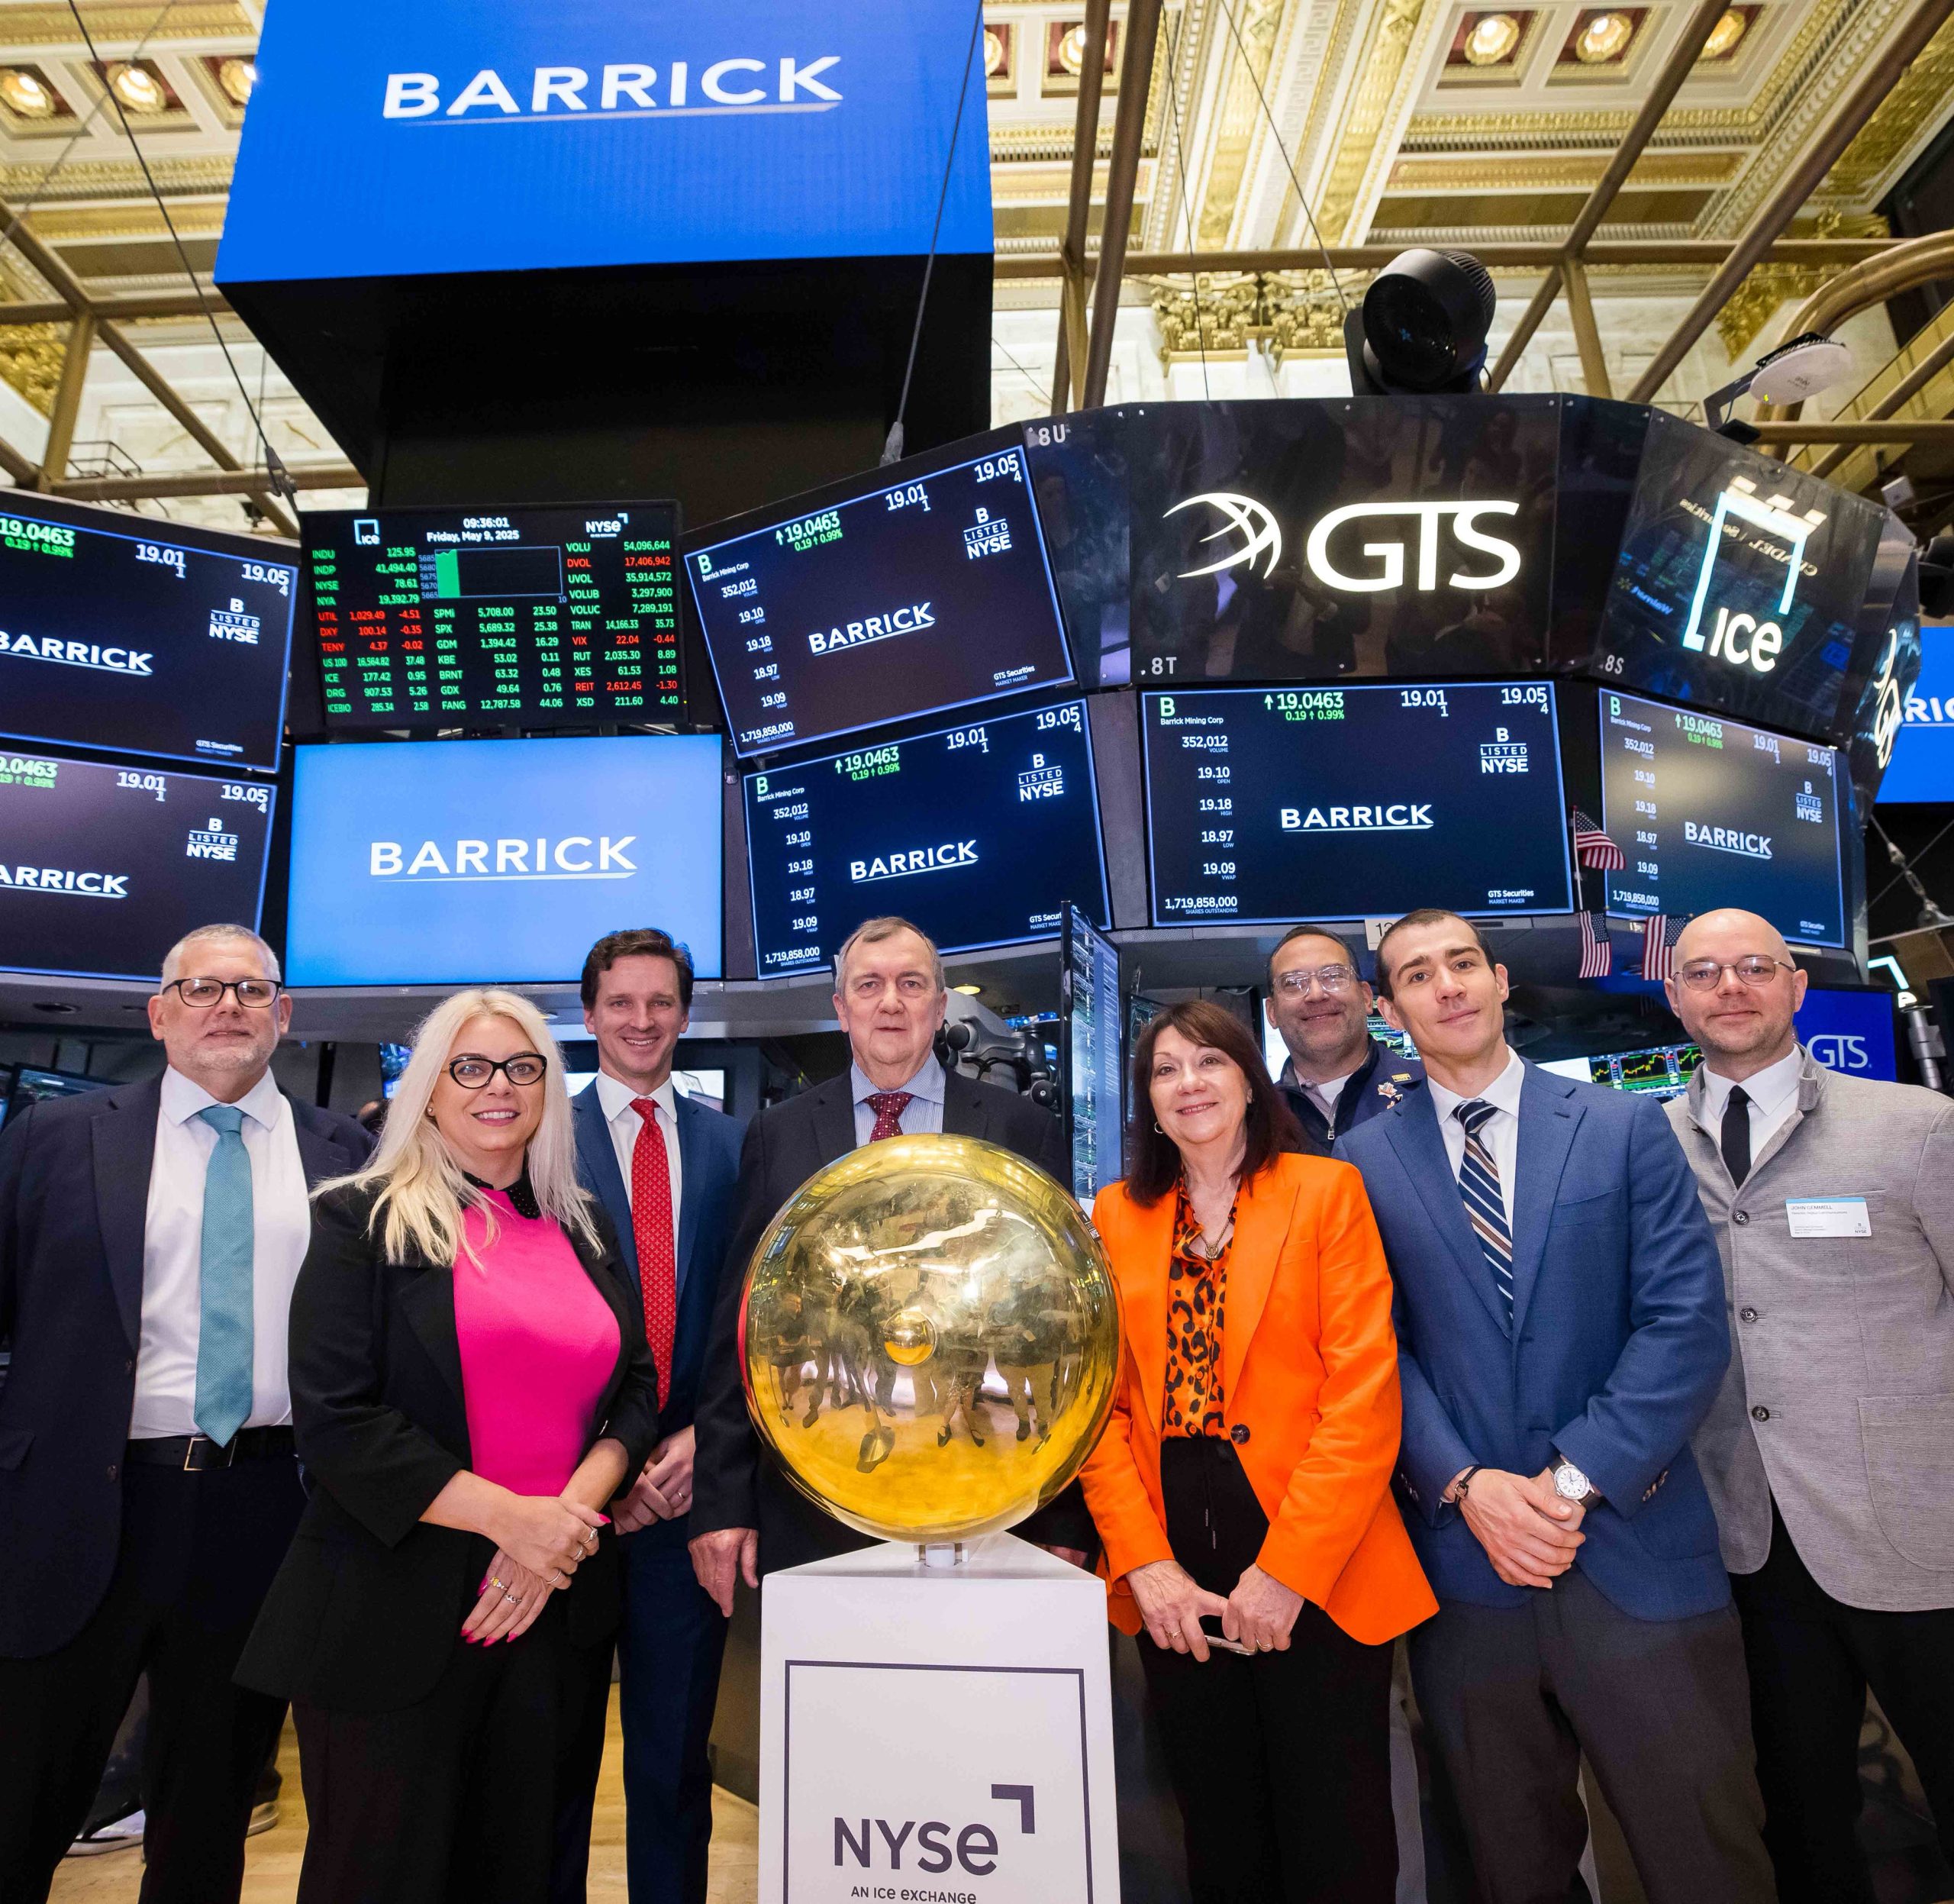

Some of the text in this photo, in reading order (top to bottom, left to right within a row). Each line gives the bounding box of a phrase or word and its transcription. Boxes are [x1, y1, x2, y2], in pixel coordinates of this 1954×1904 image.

[383, 56, 843, 119] BARRICK
[1038, 424, 1066, 446] 8U
[975, 453, 1018, 482] 19.05
[886, 485, 928, 511] 19.01
[463, 517, 509, 528] 09:36:01
[975, 508, 988, 523] B
[0, 518, 75, 546] 19.0463
[785, 511, 841, 542] 19.0463
[964, 522, 1008, 541] LISTED
[427, 530, 519, 543] Friday, May 9, 2025
[566, 541, 670, 552] VOLU 54,096,644
[967, 534, 1012, 560] NYSE
[1307, 500, 1521, 592] GTS
[136, 544, 185, 566] 19.01
[567, 557, 670, 567] DVOL 17,406,942
[698, 554, 712, 573] B
[242, 563, 289, 586] 19.05
[568, 573, 672, 583] UVOL 35,914,572
[569, 588, 672, 599] VOLUB 3,297,900
[721, 579, 756, 598] 352,012
[478, 607, 514, 618] 5,708.00
[533, 606, 556, 615] 23.50
[570, 603, 673, 615] VOLUC 7,289,191
[739, 607, 763, 623] 19.10
[211, 613, 260, 628] LISTED
[435, 621, 557, 634] SPX 5,689.32 25.38
[572, 619, 674, 630] TRAN 14,166.33 35.73
[808, 602, 936, 653] BARRICK
[209, 624, 258, 644] NYSE
[572, 637, 587, 645] VIX
[616, 635, 639, 644] 22.04
[437, 637, 559, 649] GDM 1,394.42 16.29
[746, 636, 771, 651] 19.18
[438, 653, 559, 664] KBE 53.02 0.11
[574, 650, 676, 661] RUT 2,035.30 8.89
[575, 666, 676, 676] XES 61.53 1.08
[754, 664, 777, 679] 18.97
[1151, 657, 1177, 674] 8T
[1604, 654, 1623, 675] 8S
[440, 668, 561, 679] BRNT 63.32 0.48
[576, 681, 677, 691] REIT 2,612.45 -1.30
[577, 696, 679, 706] XSD 211.60 4.40
[761, 692, 785, 707] 19.09
[1277, 692, 1344, 710] 19.0463
[1401, 691, 1447, 708] 19.01
[1501, 687, 1547, 705] 19.05
[442, 699, 563, 710] FANG 12,787.58 44.06
[1160, 697, 1175, 717] B
[1440, 705, 1448, 717] 1
[1540, 703, 1549, 714] 4
[1037, 706, 1080, 730] 19.05
[1286, 710, 1344, 721] 0.19 0.99%
[740, 721, 793, 742] 1,719,858,000
[1683, 715, 1722, 739] 19.0463
[946, 728, 988, 750] 19.01
[1182, 735, 1228, 748] 352,012
[1497, 728, 1509, 742] B
[1481, 746, 1527, 756] LISTED
[1624, 737, 1654, 754] 352,012
[1754, 734, 1780, 753] 19.01
[845, 747, 899, 772] 19.0463
[1033, 754, 1044, 768] B
[1807, 748, 1832, 766] 19.05
[1198, 766, 1230, 779] 19.10
[1482, 758, 1528, 773] NYSE
[118, 772, 166, 791] 19.01
[1018, 769, 1062, 784] LISTED
[756, 776, 769, 794] B
[1020, 780, 1063, 802] NYSE
[221, 785, 268, 803] 19.05
[774, 803, 808, 819] 352,012
[1200, 799, 1232, 811] 19.18
[1282, 804, 1433, 828] BARRICK
[1797, 807, 1822, 823] NYSE
[208, 818, 222, 831] B
[189, 834, 237, 845] LISTED
[786, 831, 811, 845] 19.10
[1201, 831, 1233, 842] 18.97
[1636, 831, 1656, 844] 18.97
[1685, 821, 1772, 856] BARRICK
[186, 844, 236, 860] NYSE
[370, 837, 638, 876] BARRICK
[788, 860, 813, 873] 19.18
[850, 840, 979, 880] BARRICK
[1637, 861, 1658, 874] 19.09
[1204, 863, 1235, 874] 19.09
[790, 888, 814, 901] 18.97
[1166, 896, 1237, 909] 1,719,858,000
[792, 917, 817, 929] 19.09
[766, 947, 820, 963] 1,719,858,000
[1807, 1034, 1869, 1068] GTS
[851, 1886, 869, 1898] AN
